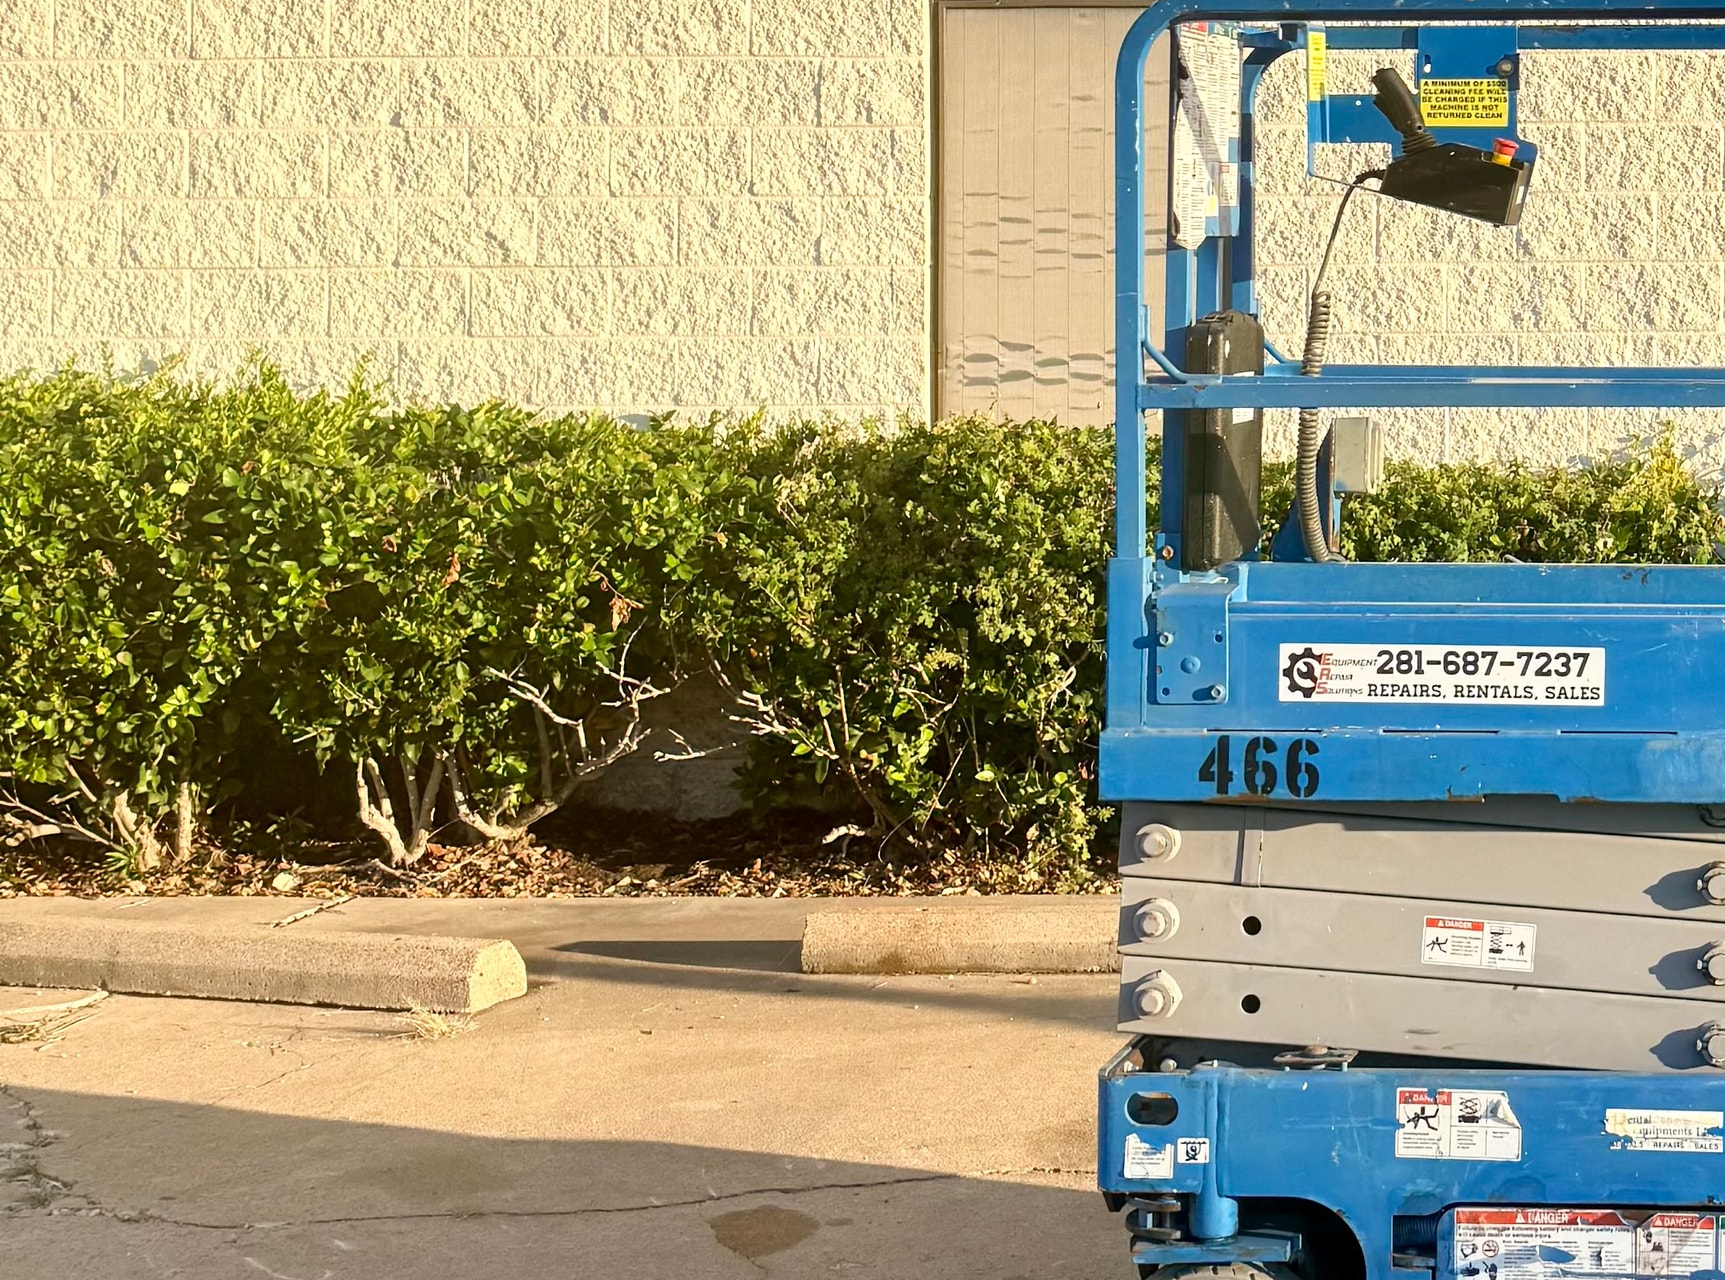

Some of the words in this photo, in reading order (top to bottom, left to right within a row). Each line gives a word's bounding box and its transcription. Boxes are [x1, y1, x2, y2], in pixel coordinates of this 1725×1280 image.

[1376, 650, 1590, 677] 281-687-7237
[1367, 683, 1447, 699] REPAIRS,
[1453, 685, 1538, 700] RENTALS,
[1545, 686, 1601, 700] SALES
[1198, 734, 1320, 798] 466
